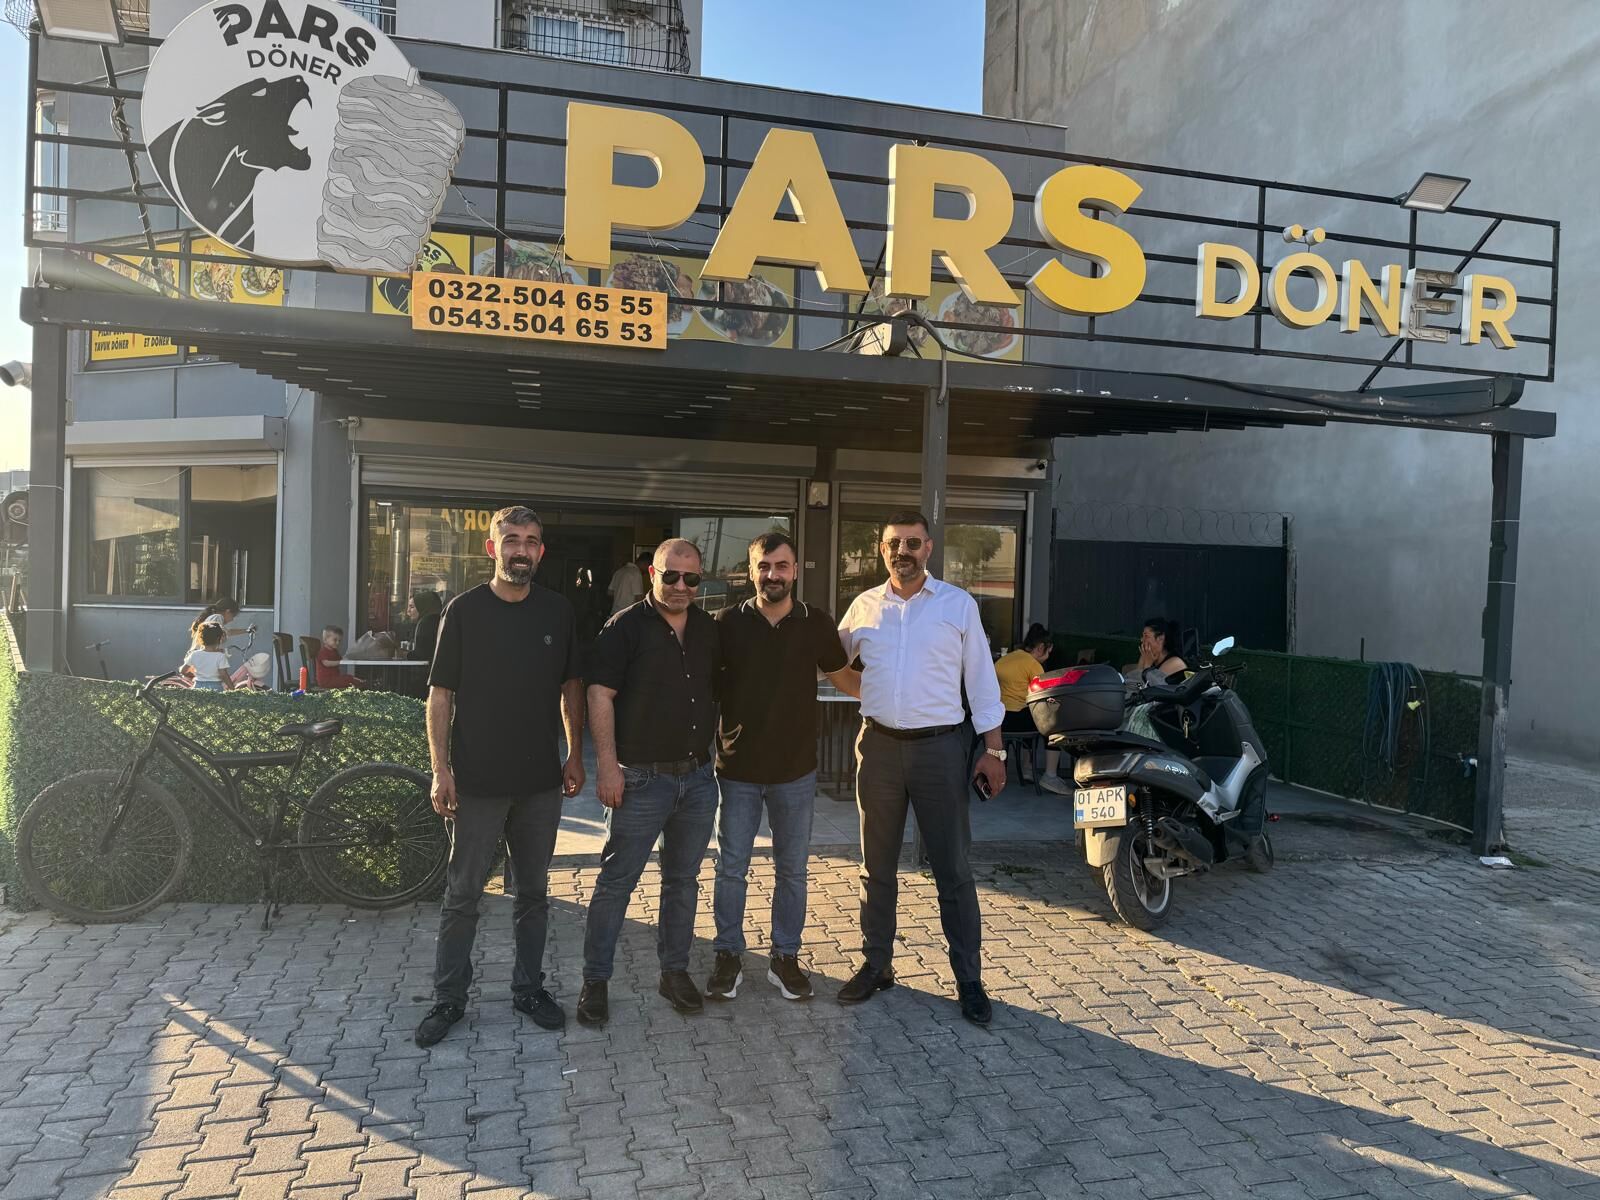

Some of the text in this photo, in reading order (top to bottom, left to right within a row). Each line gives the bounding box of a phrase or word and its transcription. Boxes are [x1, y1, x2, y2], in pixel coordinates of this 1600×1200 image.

[213, 0, 376, 67] PARS
[247, 43, 342, 85] DÖNER
[564, 101, 1518, 350] PARS DÖNER
[428, 278, 653, 316] 0322.504 65 55
[428, 305, 653, 343] 0543.504 65 53
[1078, 788, 1123, 805] 01 APK
[1091, 806, 1115, 819] 540
